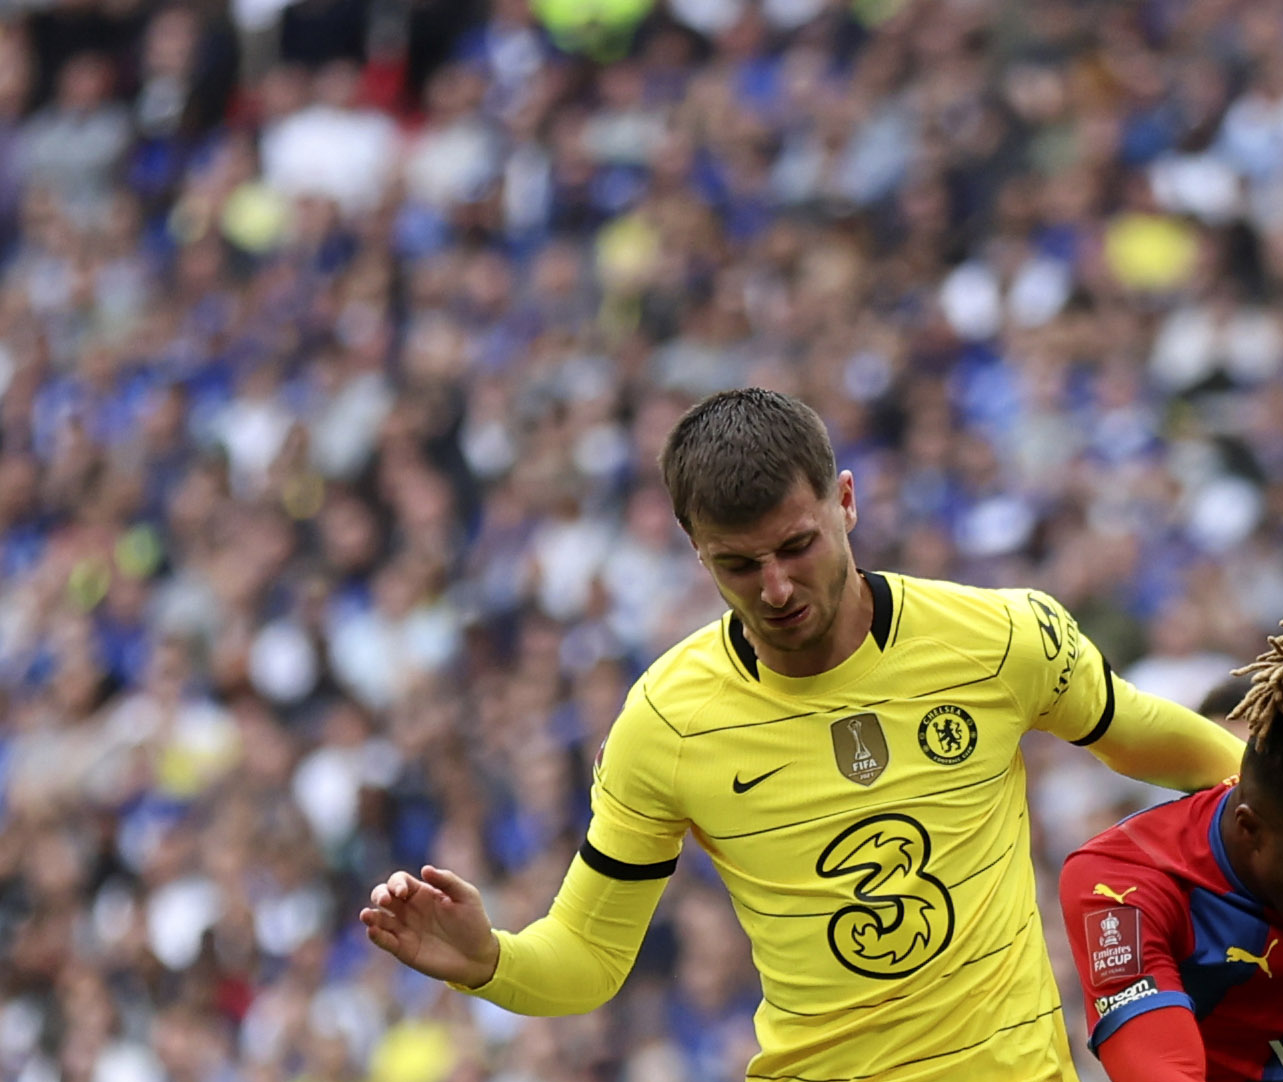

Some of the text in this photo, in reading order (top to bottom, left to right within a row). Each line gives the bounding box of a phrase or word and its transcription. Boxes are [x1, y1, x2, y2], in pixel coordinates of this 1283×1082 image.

[923, 706, 962, 726] CHELSEA
[852, 758, 877, 772] FIFA
[1093, 945, 1132, 961] Emirates
[1094, 960, 1107, 973] FA
[1106, 953, 1132, 968] CUP
[1108, 979, 1150, 1005] room
